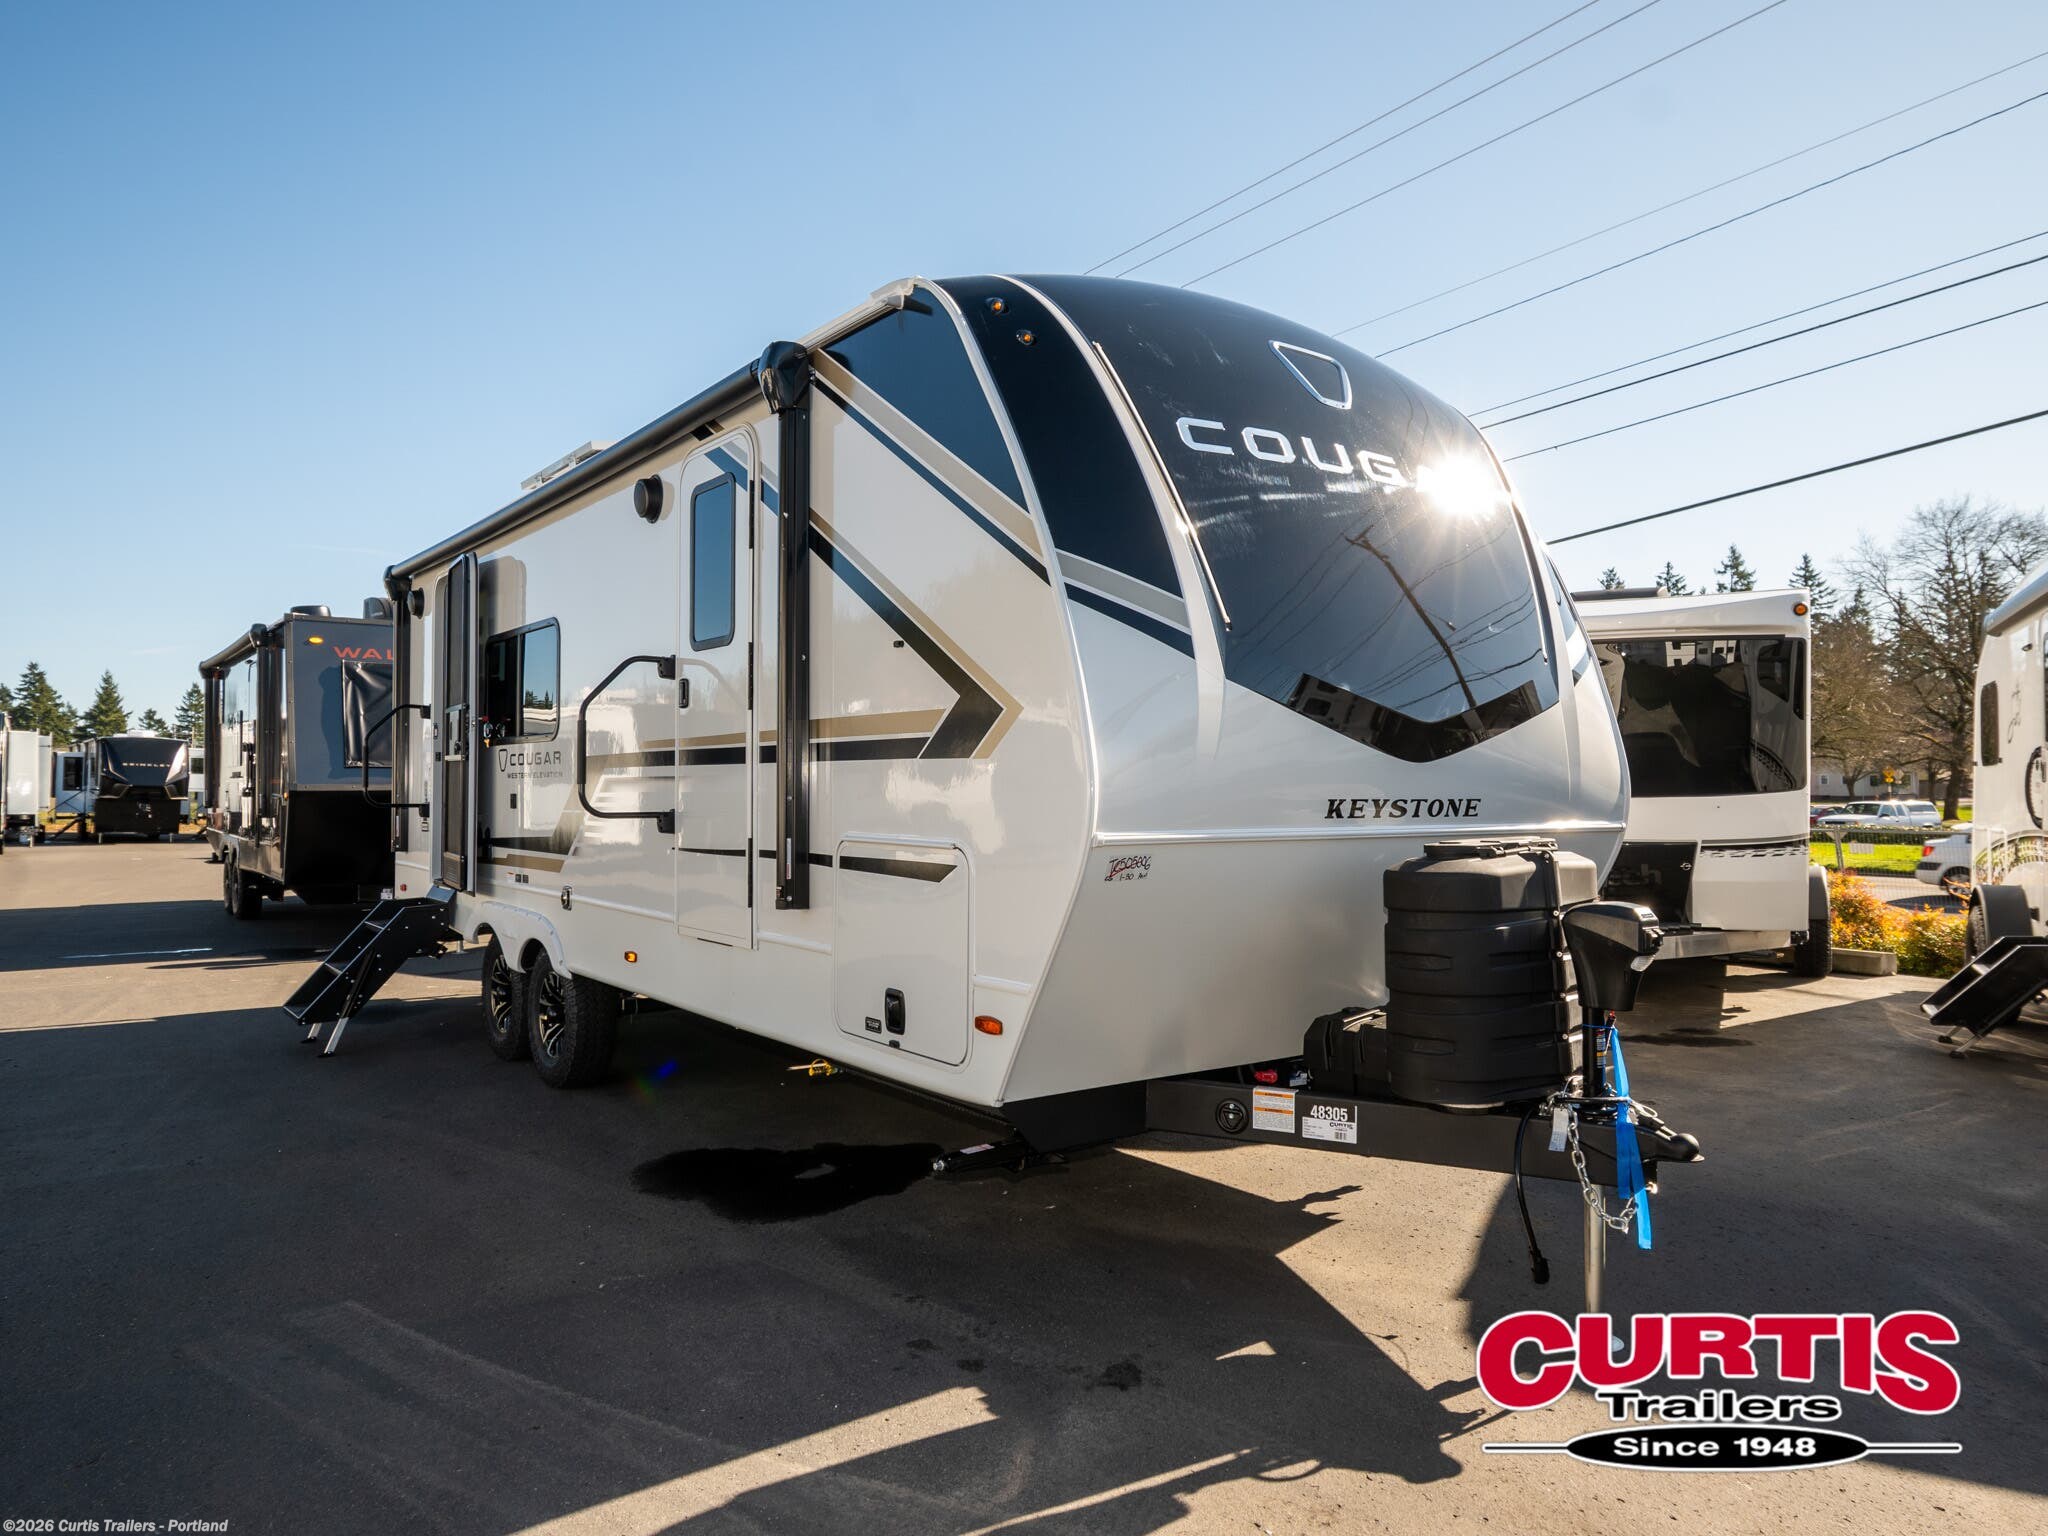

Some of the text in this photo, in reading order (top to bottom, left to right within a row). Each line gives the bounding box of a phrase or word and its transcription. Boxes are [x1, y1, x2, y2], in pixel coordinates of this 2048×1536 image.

[1175, 416, 1440, 492] COUG
[510, 751, 561, 766] COUGAR
[1324, 798, 1482, 819] KEYSTONE
[1310, 1104, 1348, 1121] 48305
